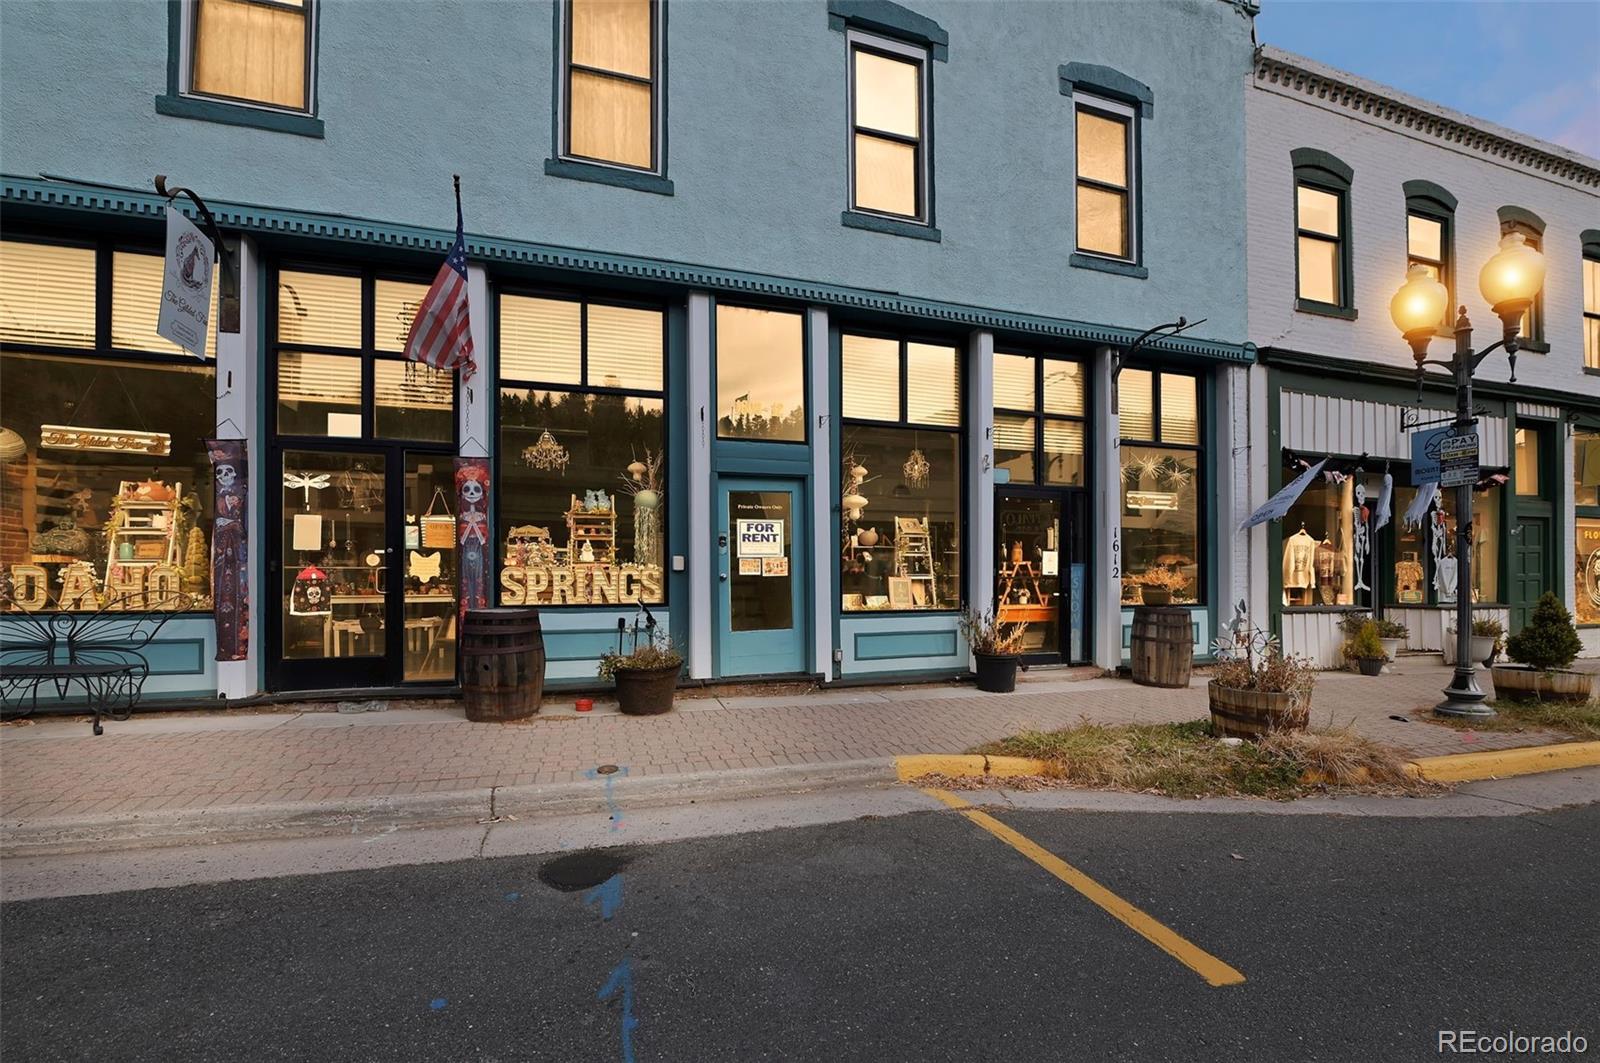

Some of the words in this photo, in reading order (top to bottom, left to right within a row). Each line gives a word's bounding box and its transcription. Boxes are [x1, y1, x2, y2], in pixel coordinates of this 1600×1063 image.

[1451, 435, 1476, 445] PAY
[746, 523, 774, 533] FOR
[741, 533, 779, 543] RENT
[1112, 527, 1120, 578] 1612
[501, 565, 662, 605] SPRINGS
